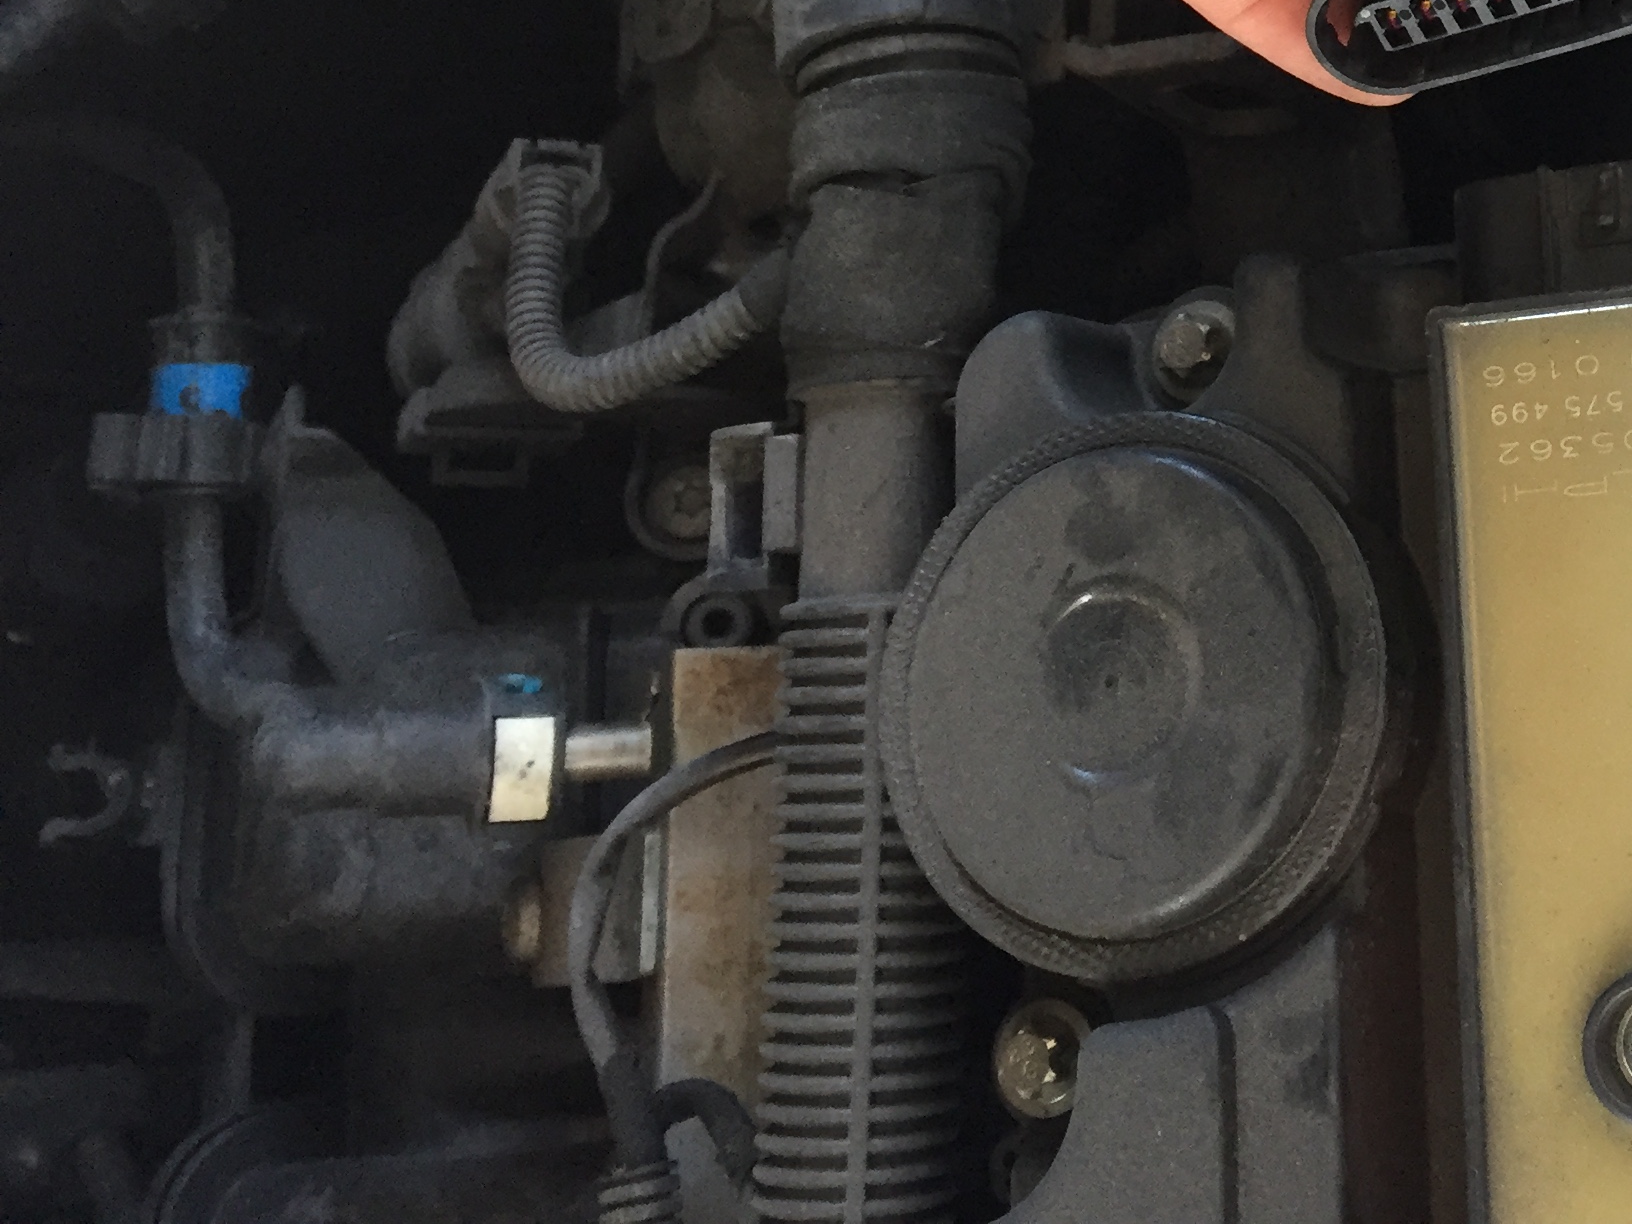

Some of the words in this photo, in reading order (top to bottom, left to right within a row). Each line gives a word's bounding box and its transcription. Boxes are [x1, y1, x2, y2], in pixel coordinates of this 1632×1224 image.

[1482, 354, 1600, 387] 0166
[1490, 402, 1549, 426] 499
[1565, 390, 1624, 417] 575
